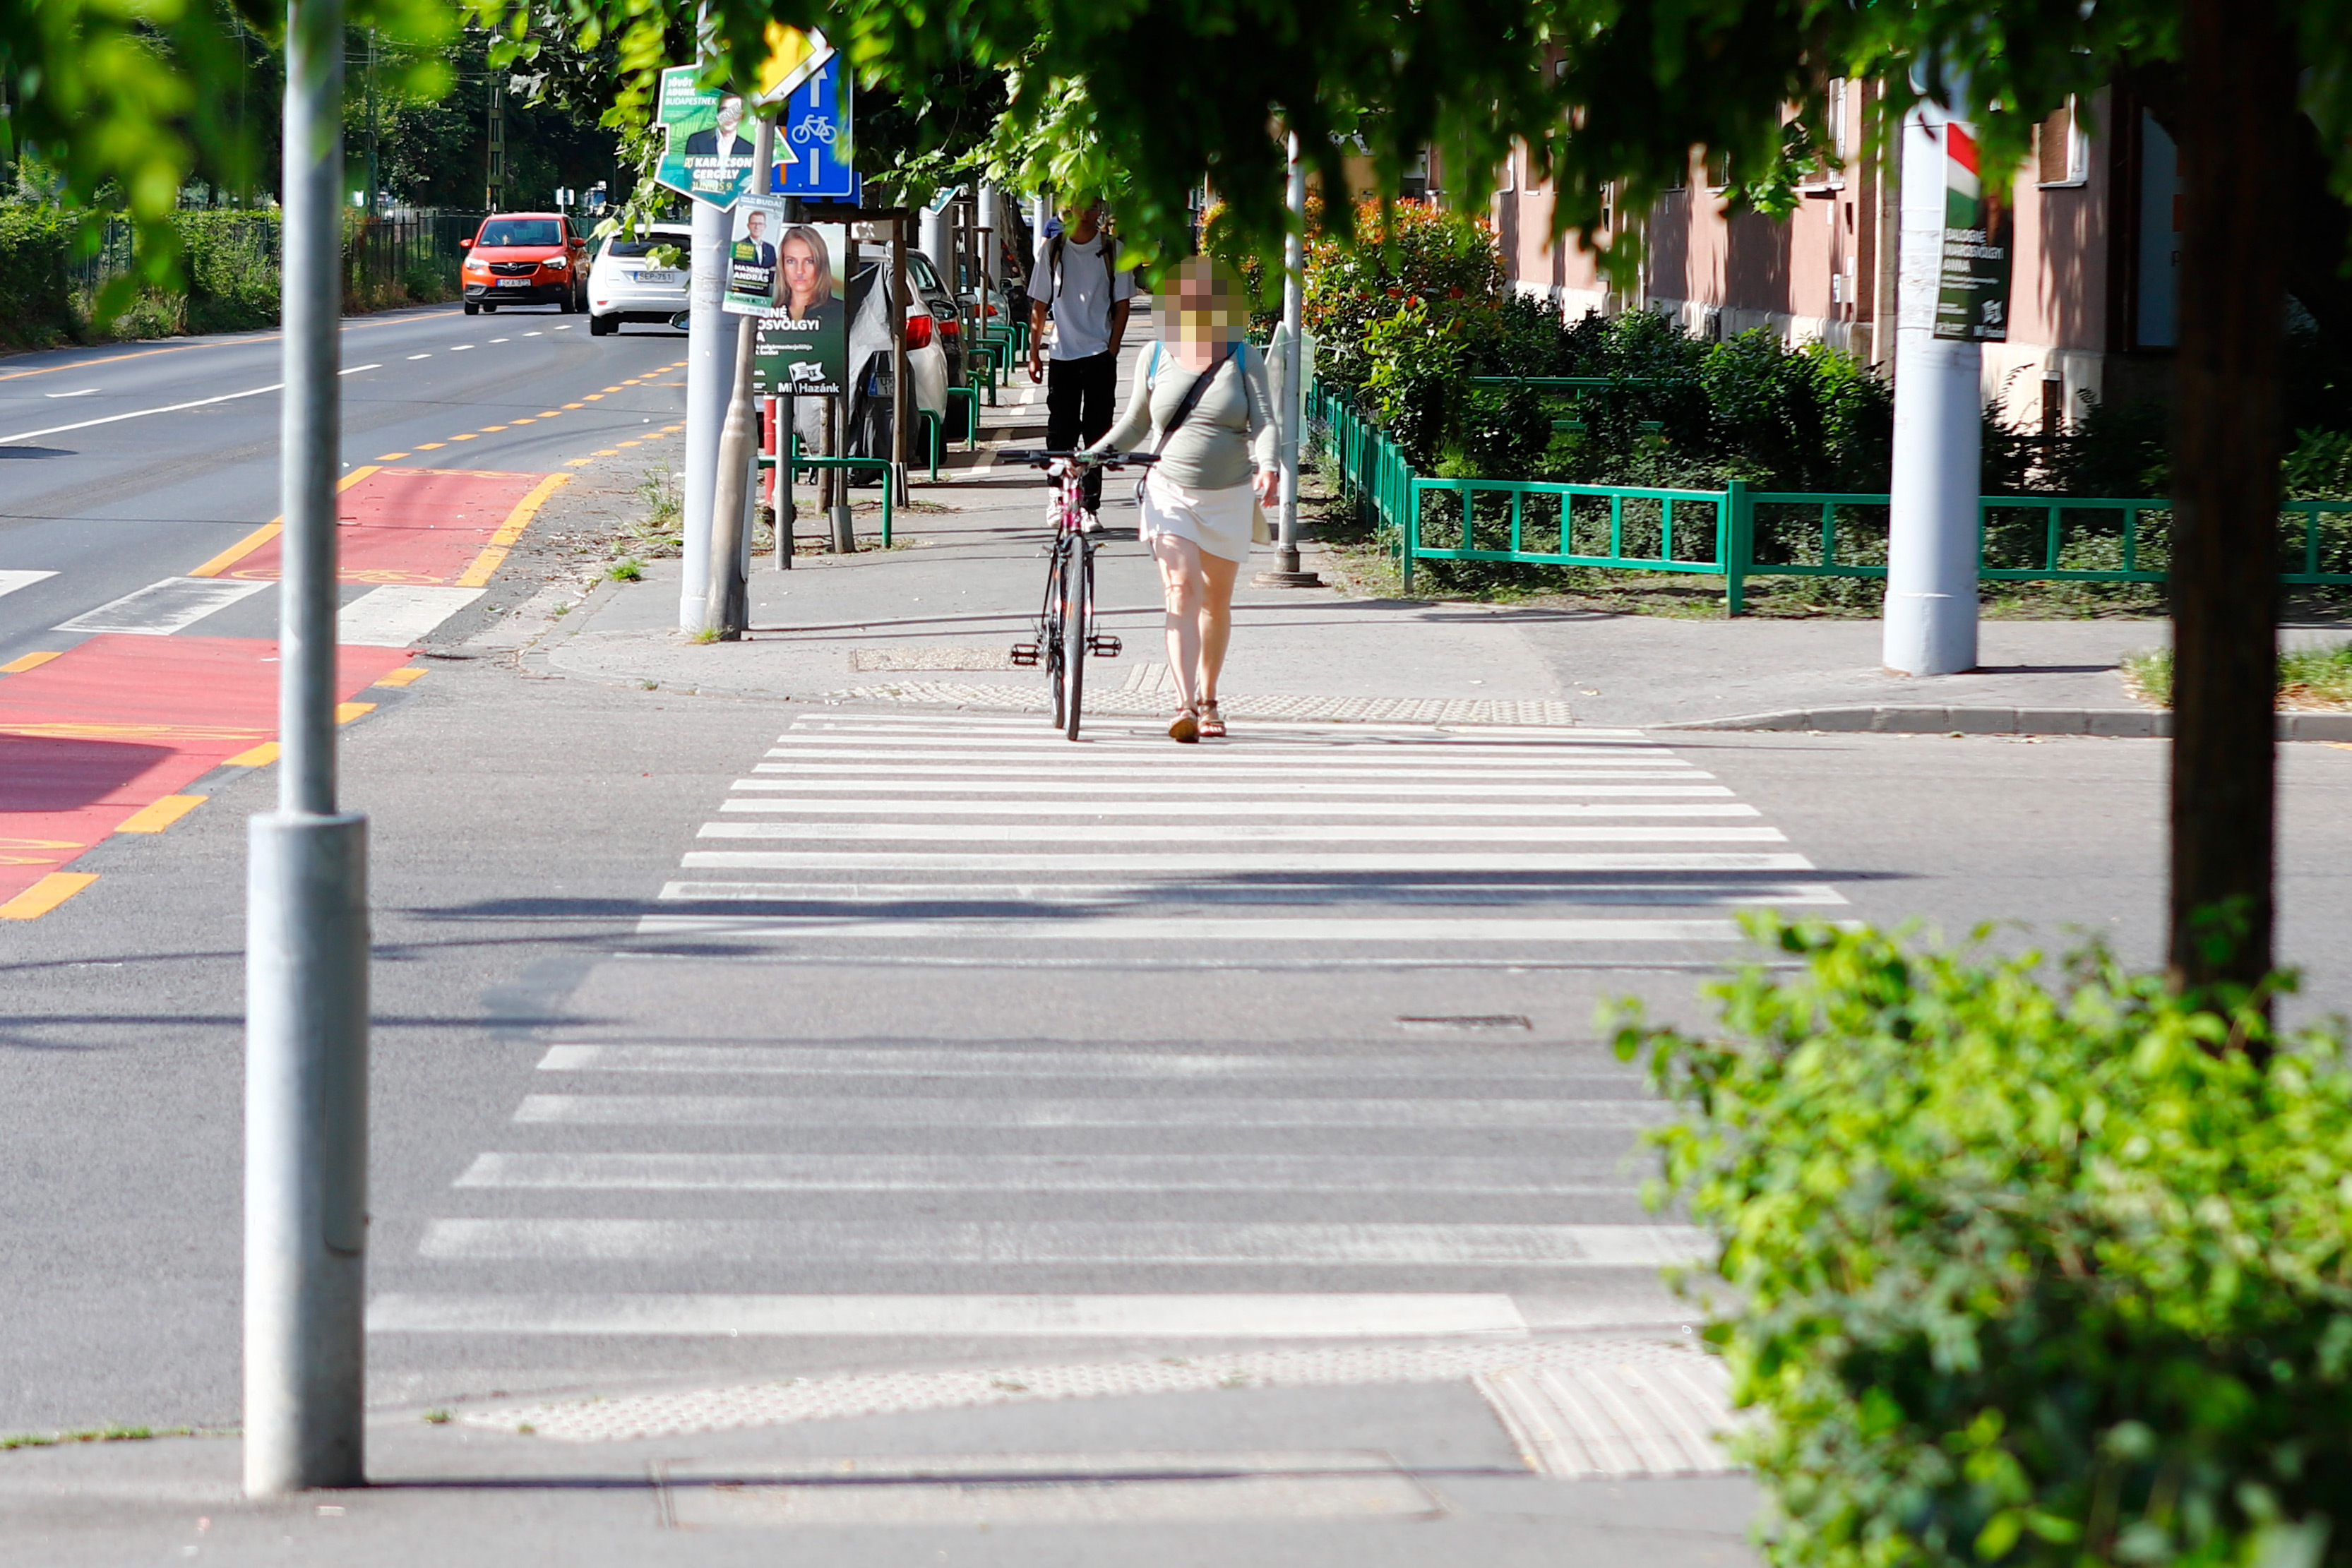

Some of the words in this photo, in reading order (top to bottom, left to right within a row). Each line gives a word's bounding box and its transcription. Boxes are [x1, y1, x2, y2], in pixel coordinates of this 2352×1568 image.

[666, 88, 696, 96] ADUNK
[665, 97, 717, 105] BUDAPESTNEK
[693, 169, 739, 179] GERGELY
[734, 265, 770, 275] MAJOROS
[733, 271, 769, 282] ANDRÁS
[777, 383, 792, 393] Mi
[799, 383, 839, 393] Hazánk
